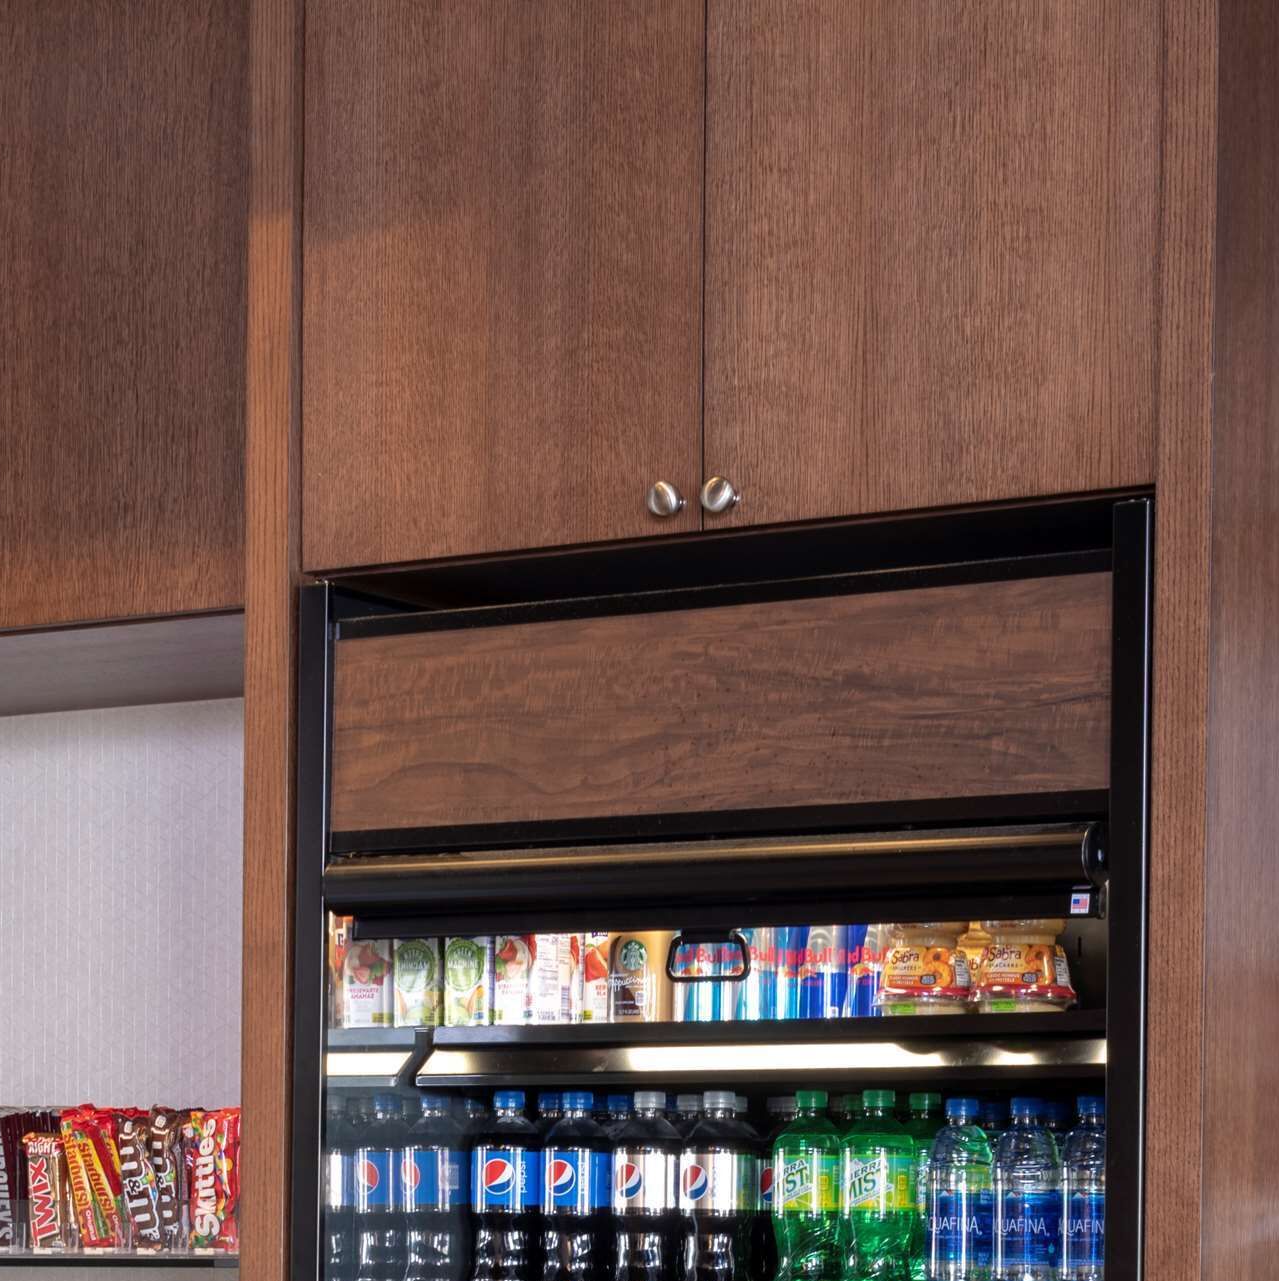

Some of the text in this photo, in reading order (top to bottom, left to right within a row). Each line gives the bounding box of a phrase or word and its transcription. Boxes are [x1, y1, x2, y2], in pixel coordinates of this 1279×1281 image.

[892, 951, 919, 965] Sabra
[988, 944, 1022, 961] Sabra
[28, 1158, 61, 1248] TWIX
[64, 1132, 90, 1211] Starburst
[80, 1141, 116, 1213] Starburst
[193, 1118, 221, 1237] Skittles
